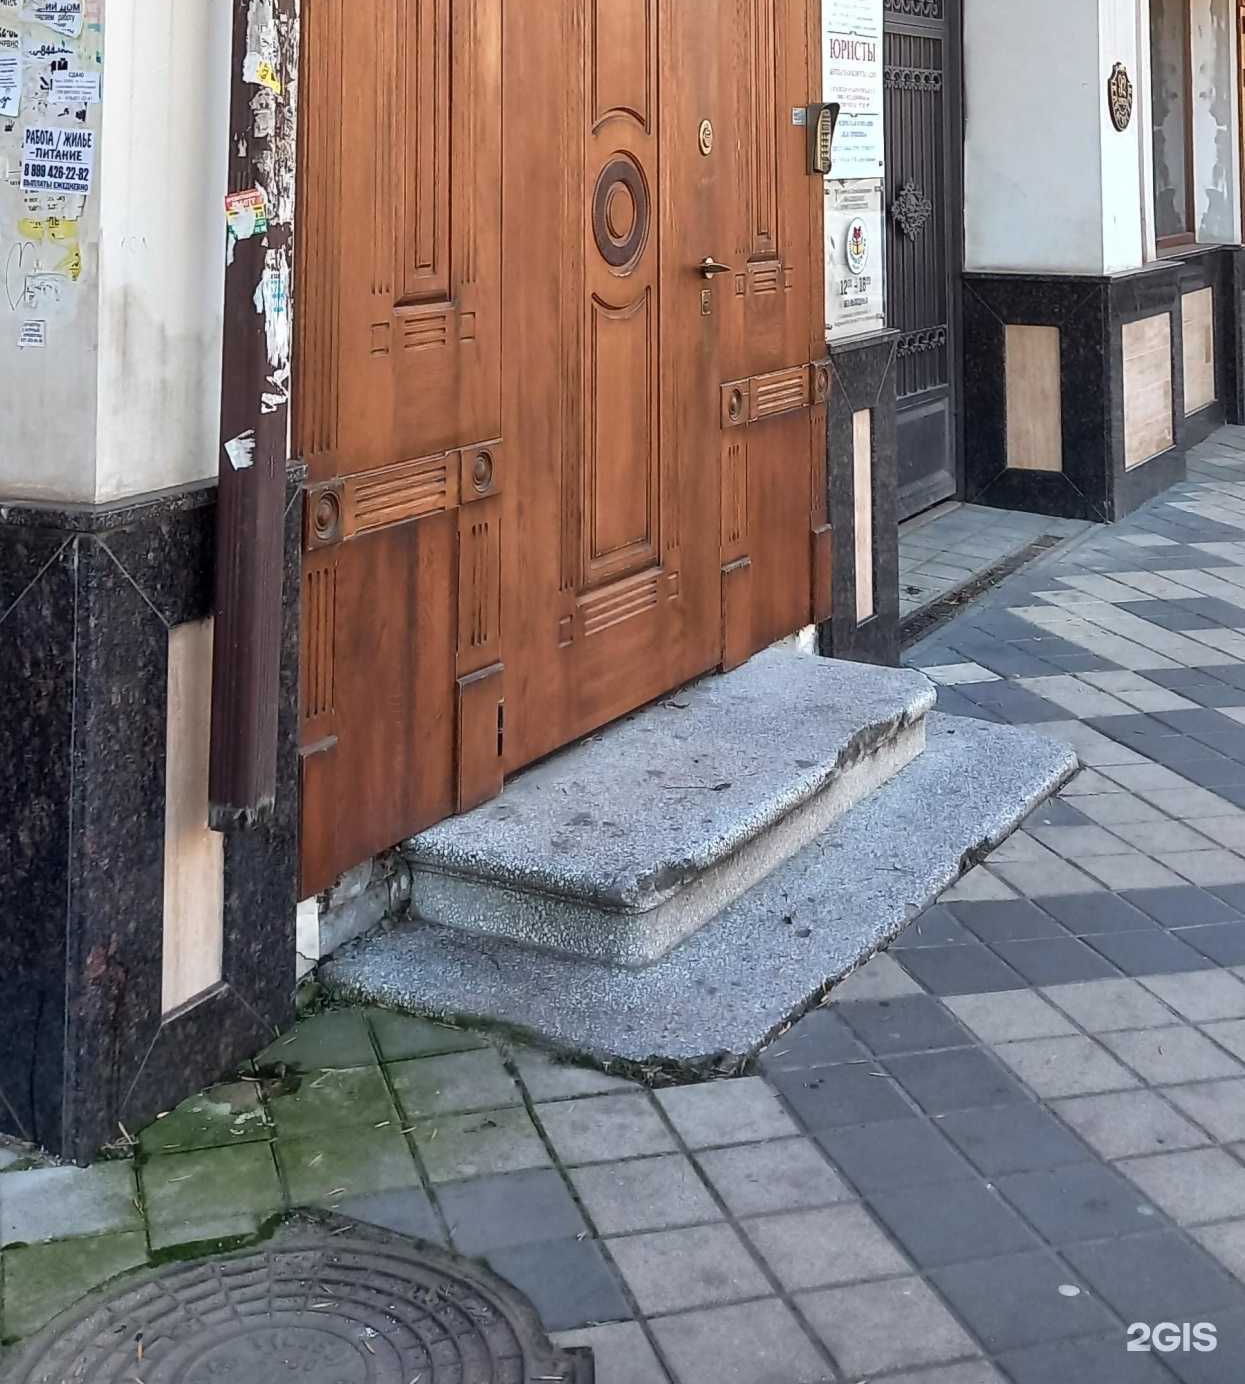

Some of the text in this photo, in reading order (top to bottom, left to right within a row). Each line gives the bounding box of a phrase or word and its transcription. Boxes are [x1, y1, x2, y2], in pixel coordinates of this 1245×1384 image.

[829, 39, 876, 62] ЮРИСТЫ
[25, 129, 54, 146] РАБОТА
[63, 132, 92, 149] ЖИЛЬЕ
[24, 163, 30, 176] 8
